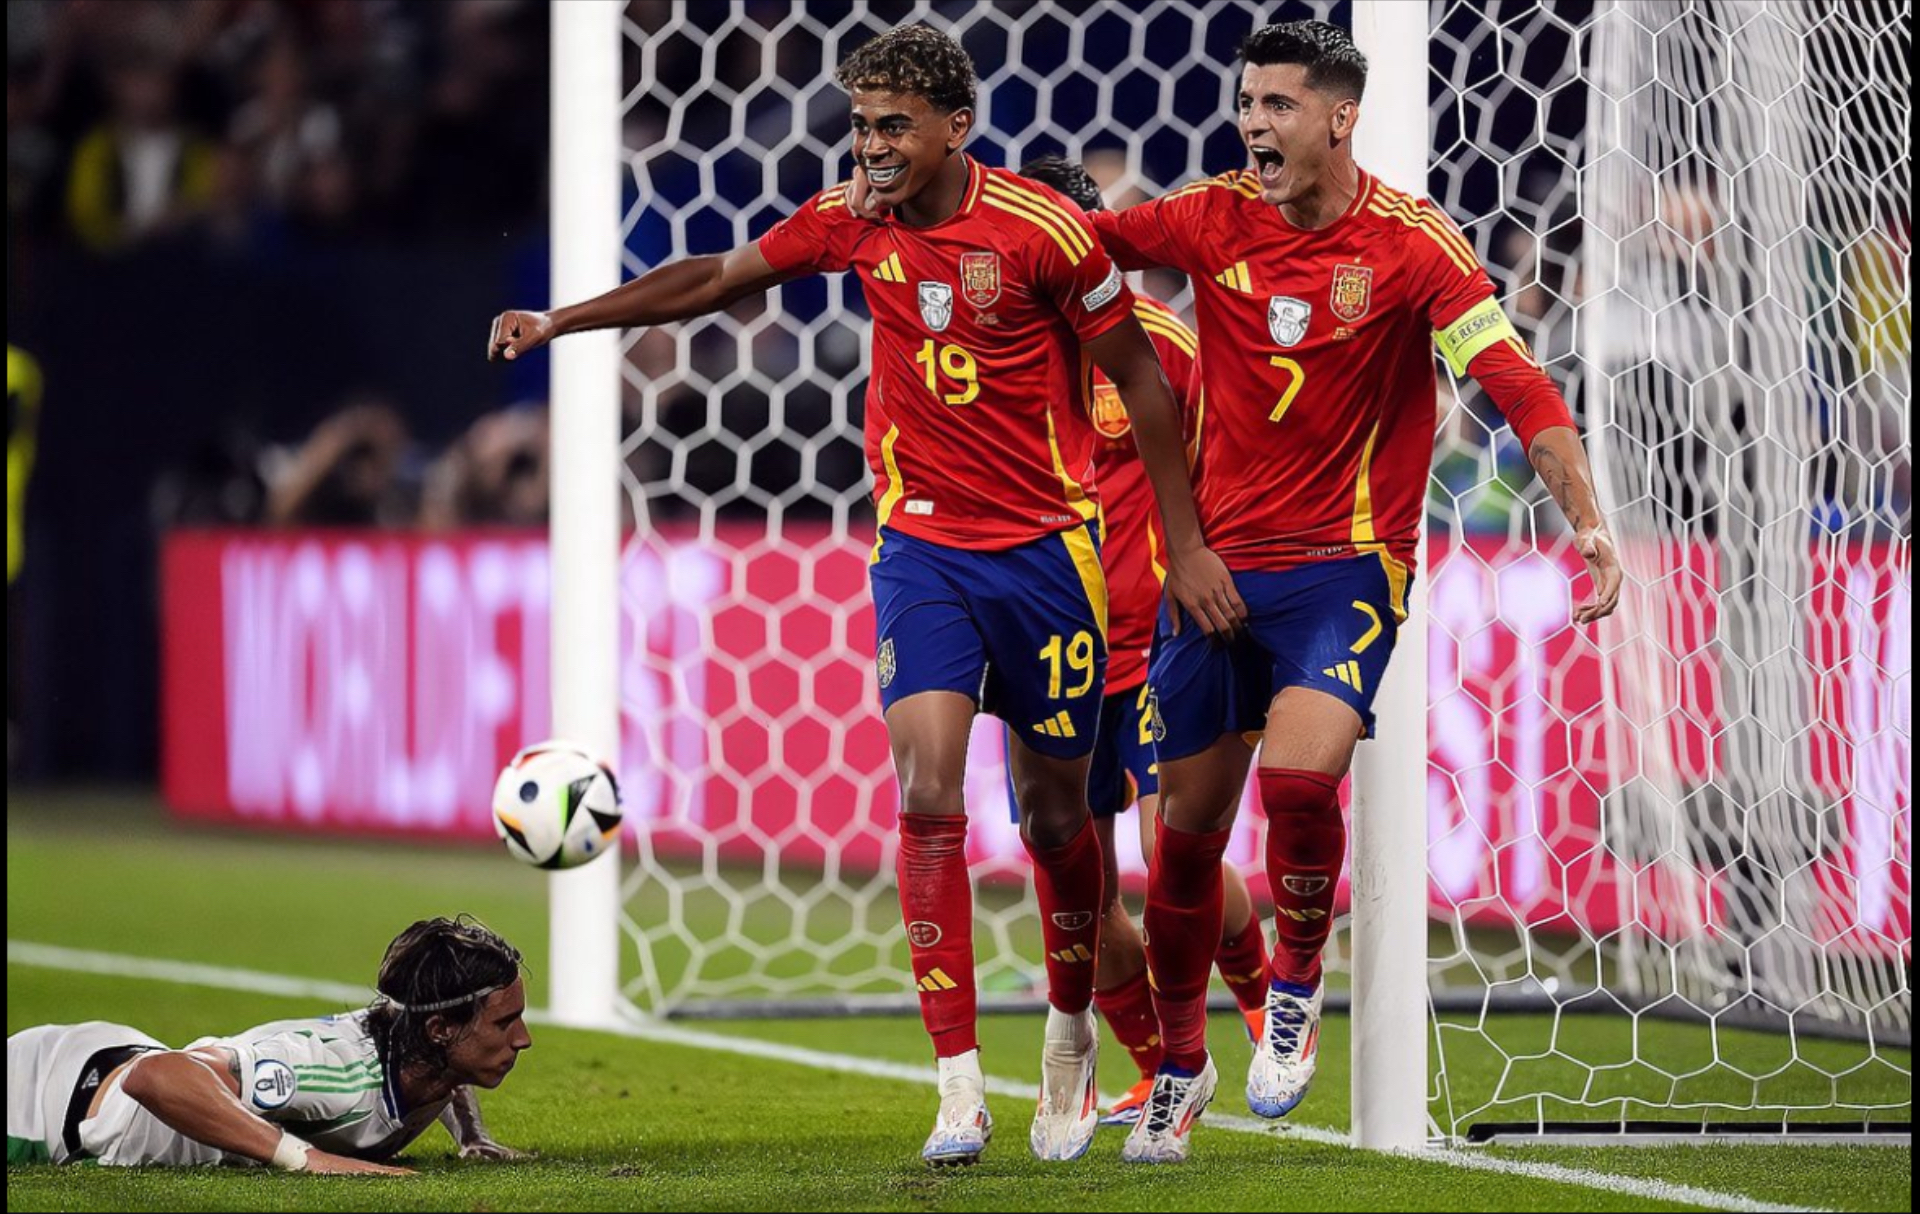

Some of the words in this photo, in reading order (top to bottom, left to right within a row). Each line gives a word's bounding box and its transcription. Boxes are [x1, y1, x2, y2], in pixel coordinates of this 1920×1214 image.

[915, 339, 980, 405] 19
[1268, 355, 1305, 423] 7
[1349, 600, 1382, 654] 7
[1040, 630, 1094, 699] 19
